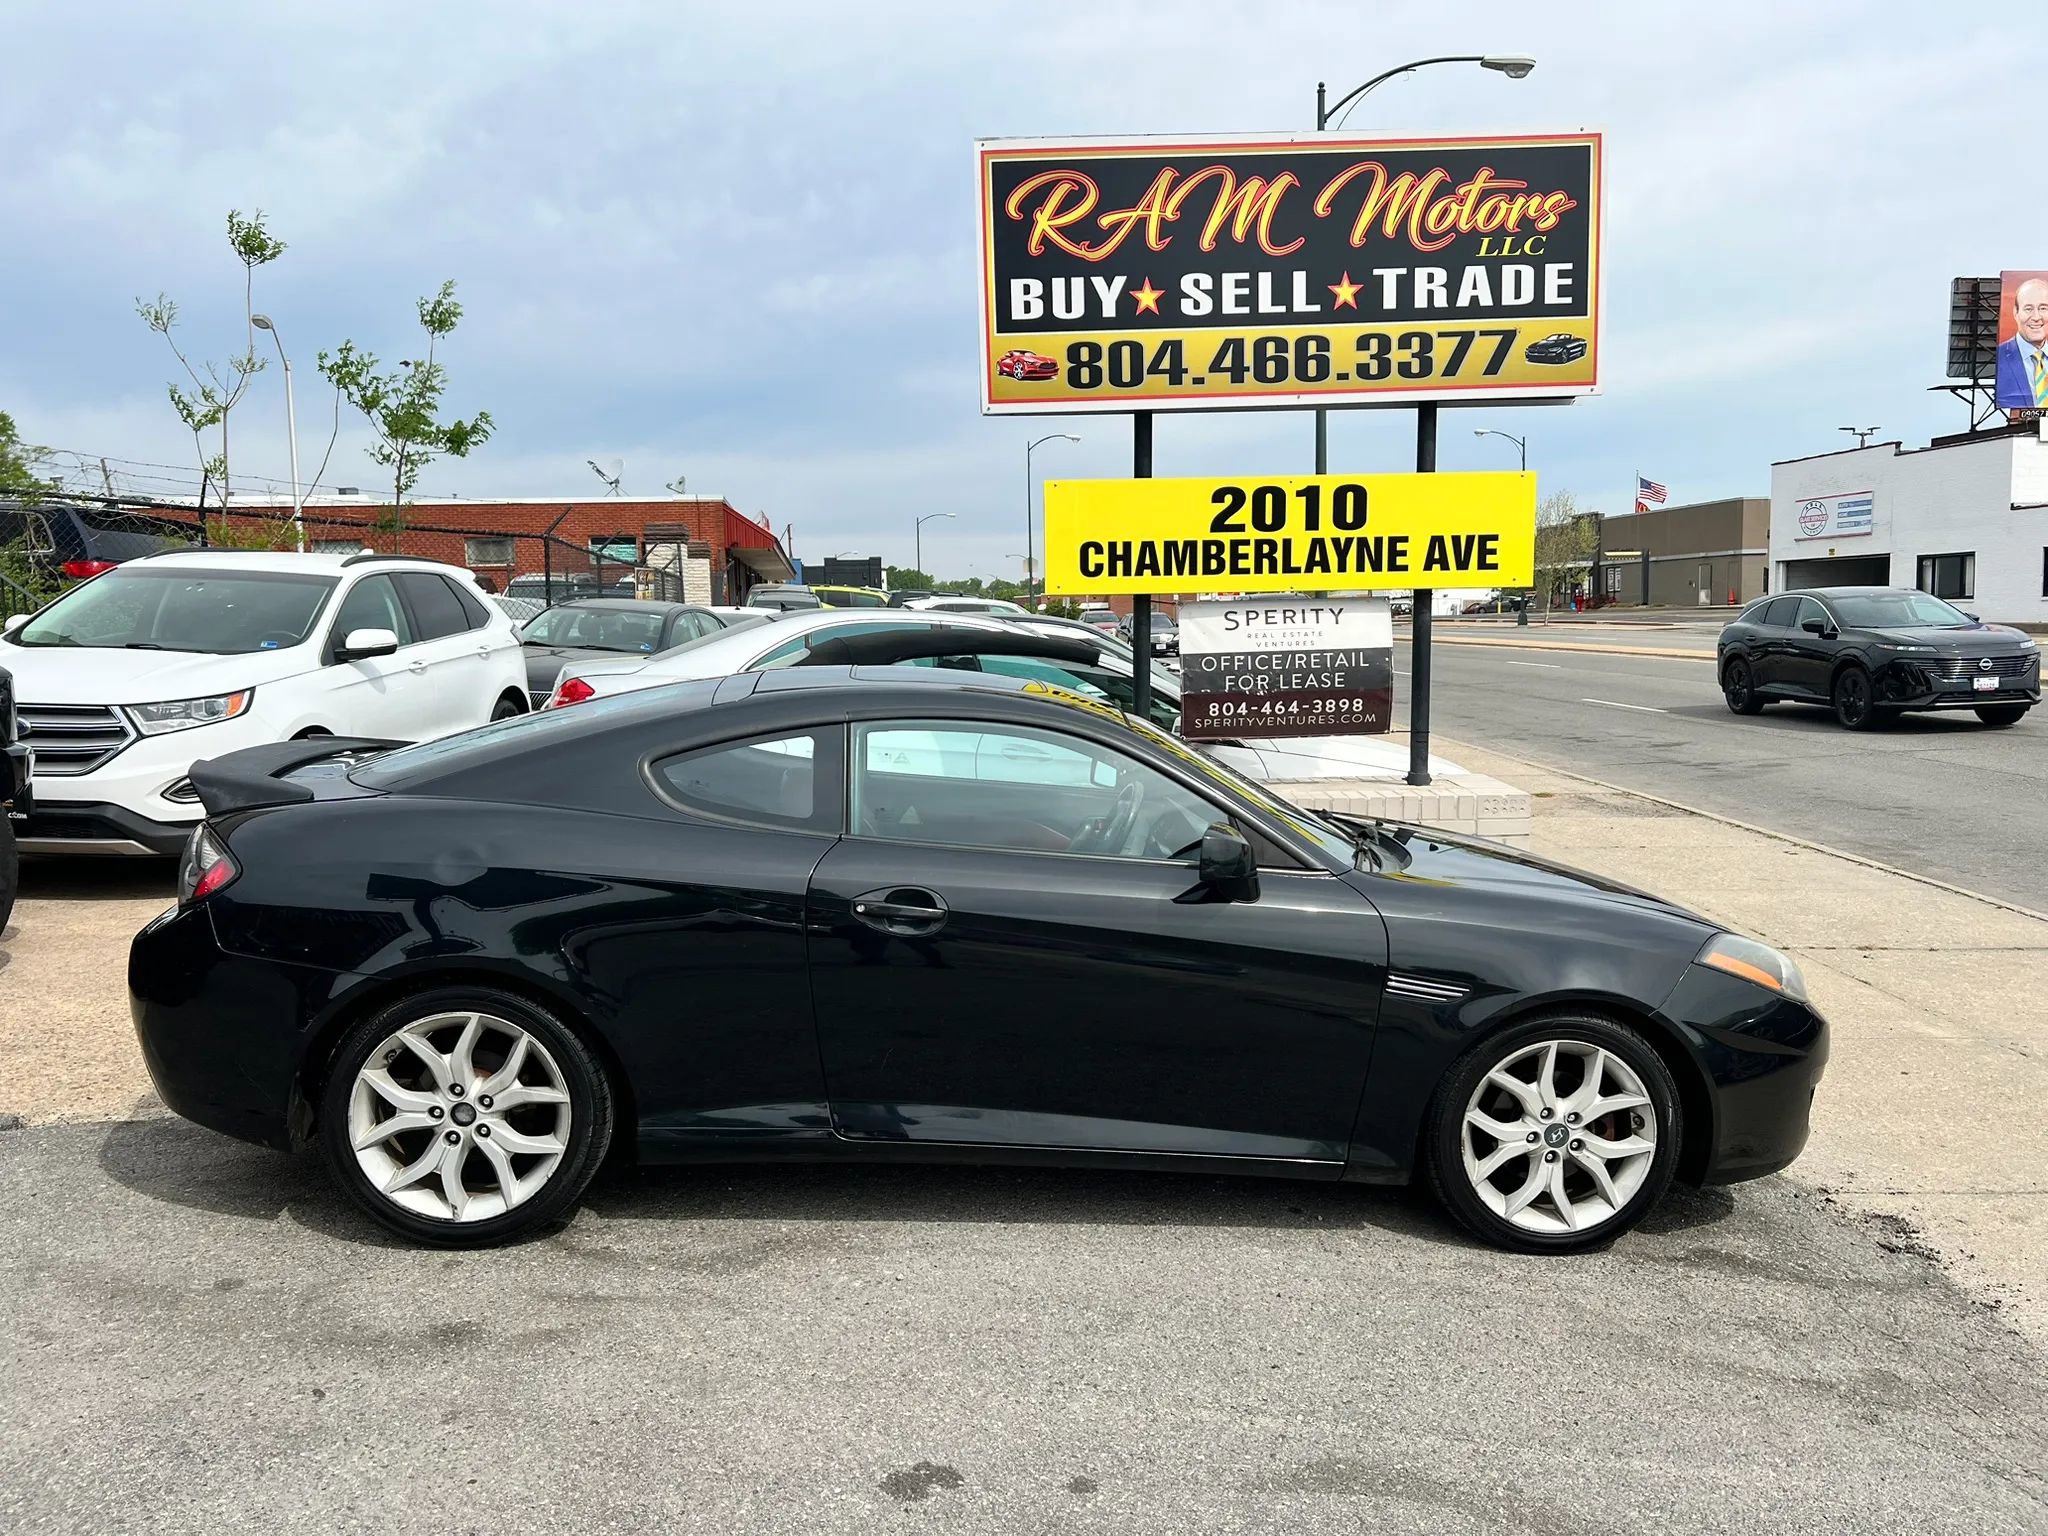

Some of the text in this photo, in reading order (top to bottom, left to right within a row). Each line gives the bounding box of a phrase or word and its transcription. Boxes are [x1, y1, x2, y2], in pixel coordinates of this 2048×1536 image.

[1005, 160, 1577, 261] RAM Motors
[1476, 235, 1547, 257] LLC
[1010, 262, 1574, 320] BUY SELL TRADE
[1066, 329, 1519, 390] 804.466.3377
[1210, 483, 1368, 533] 2010
[1079, 534, 1499, 578] CHAMBERLAYNE AVE
[1224, 607, 1344, 631] SPERITY
[1256, 640, 1315, 648] VENTURES
[1201, 651, 1369, 672] OFFICE/RETAIL
[1225, 672, 1345, 690] FOR LEASE
[1208, 698, 1363, 717] 804-464-3898
[1194, 713, 1377, 729] SPERITYVENTURES.COM
